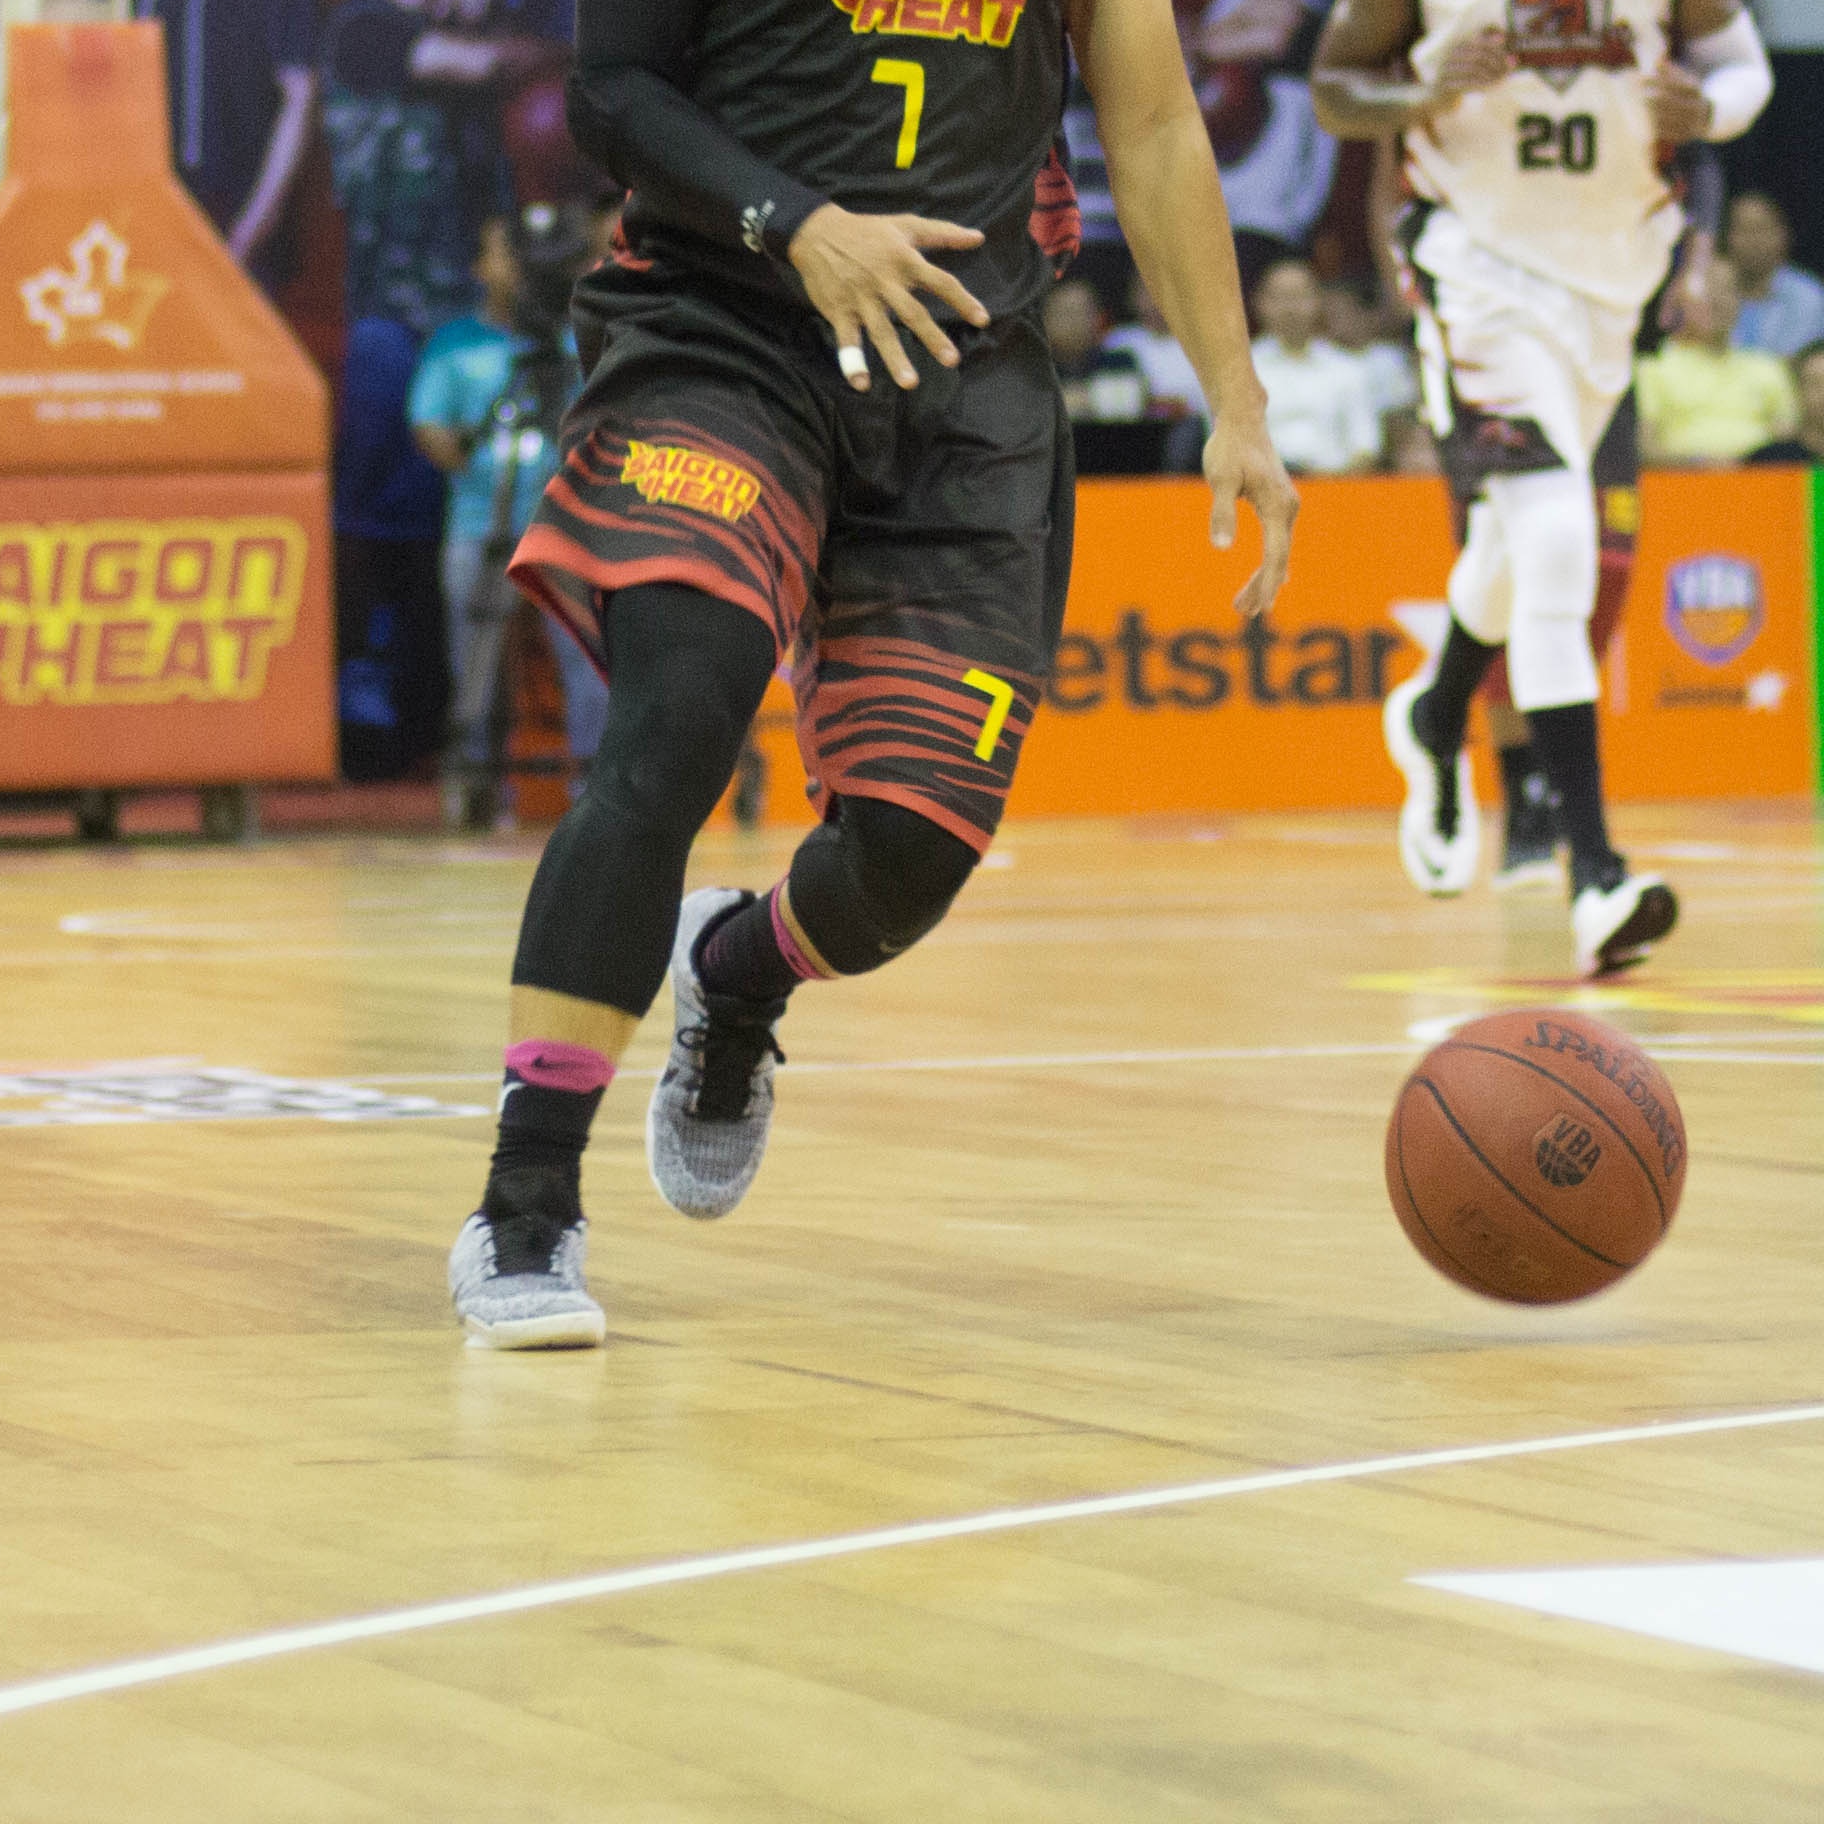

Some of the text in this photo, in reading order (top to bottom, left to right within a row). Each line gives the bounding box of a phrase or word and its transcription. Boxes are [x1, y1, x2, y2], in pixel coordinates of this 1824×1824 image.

[871, 58, 925, 169] 7
[1517, 112, 1597, 172] 20
[2, 614, 280, 702] HEAT
[962, 668, 1015, 762] 7
[1552, 1118, 1602, 1174] VBA
